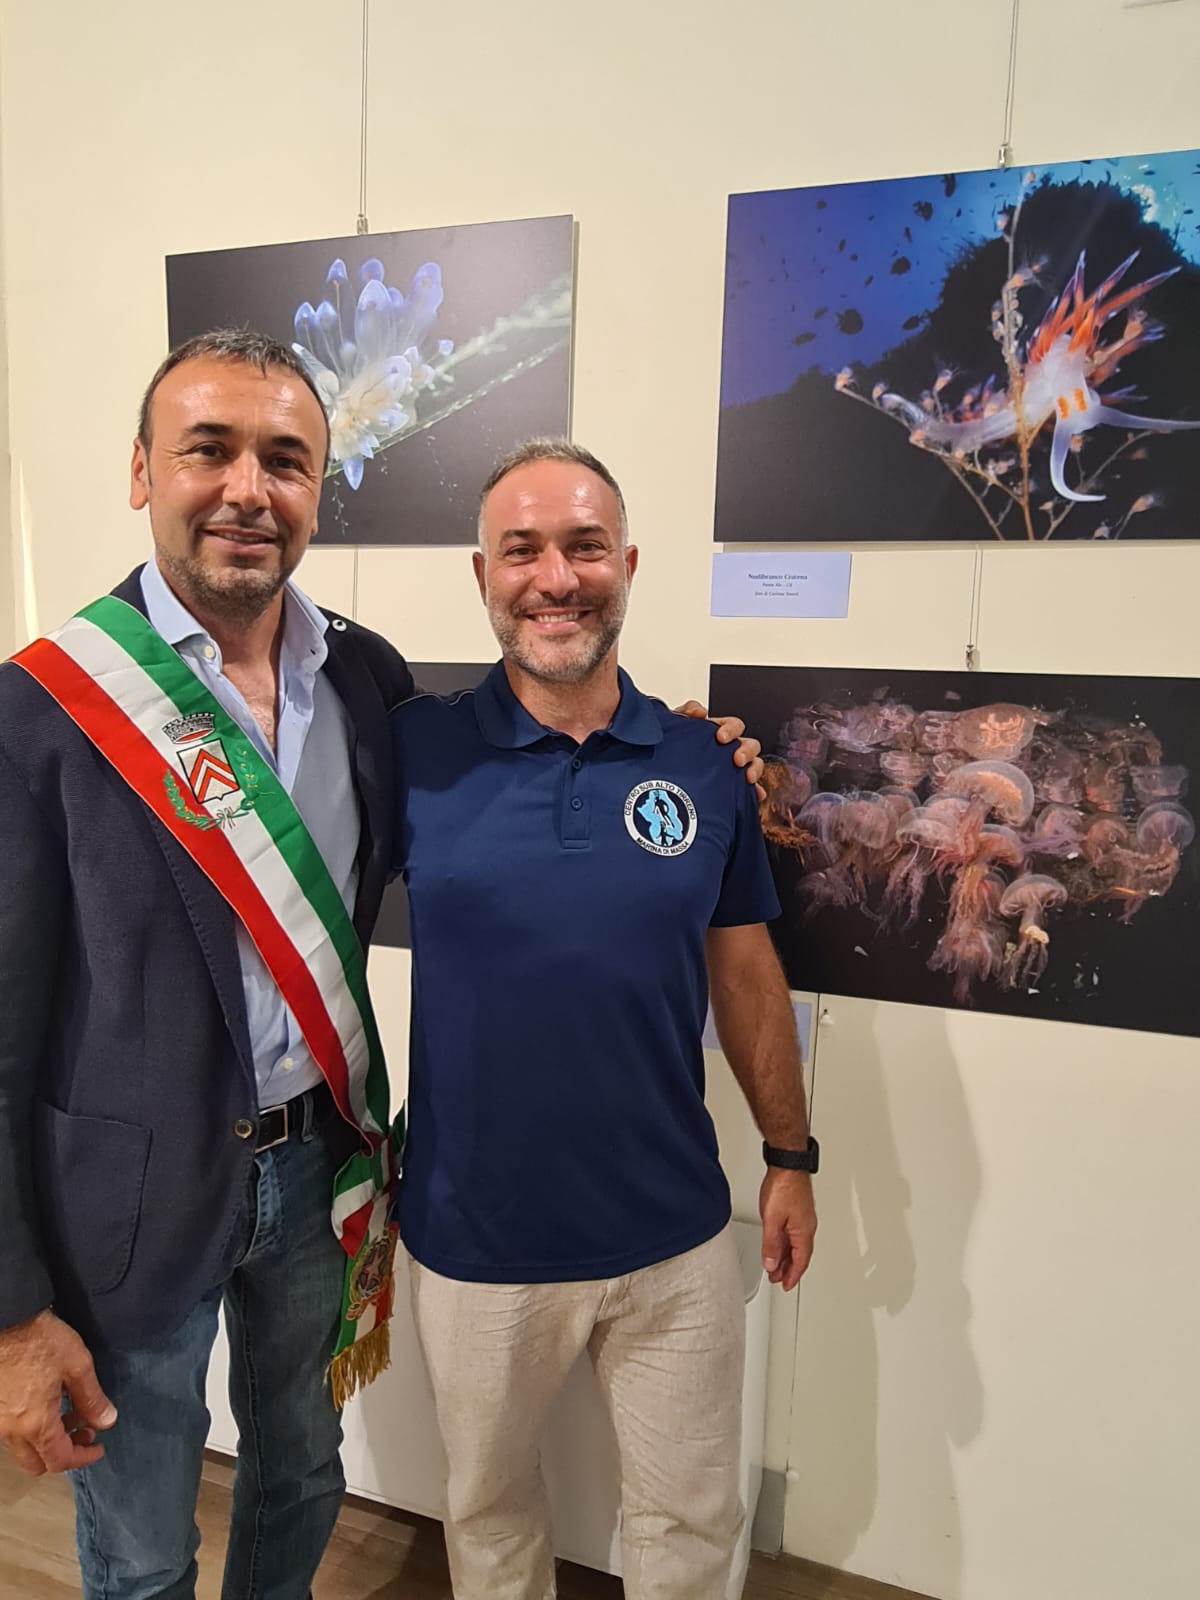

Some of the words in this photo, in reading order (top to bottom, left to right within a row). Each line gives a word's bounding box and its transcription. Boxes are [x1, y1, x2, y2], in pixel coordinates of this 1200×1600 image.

[624, 789, 640, 816] CENTRO
[638, 782, 654, 792] SUB
[655, 782, 675, 791] ALTO
[676, 789, 696, 820] TIRRENO
[636, 837, 662, 854] MARINA
[670, 840, 689, 855] MASSA
